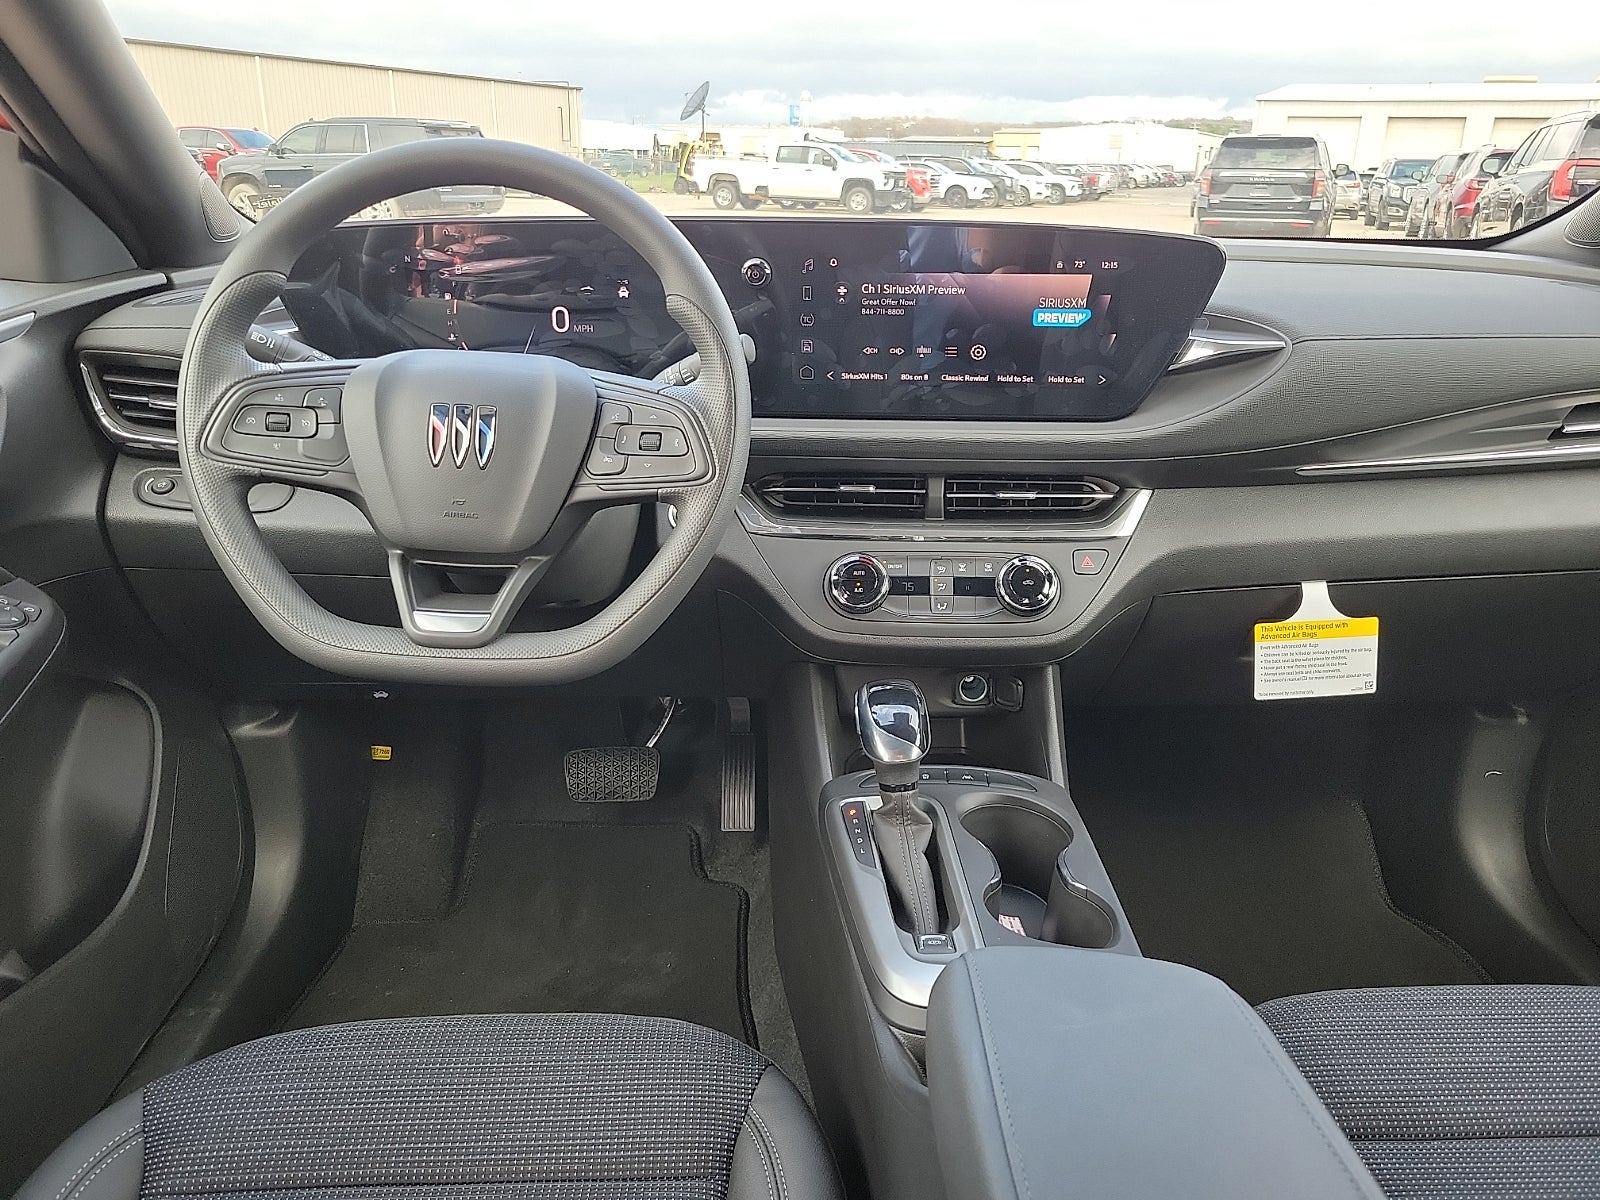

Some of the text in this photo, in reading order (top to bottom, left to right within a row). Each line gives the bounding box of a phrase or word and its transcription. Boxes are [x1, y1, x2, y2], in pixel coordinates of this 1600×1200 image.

[1101, 261, 1118, 269] 12:15
[861, 284, 875, 294] Ch
[883, 284, 926, 294] SiriusXM
[928, 284, 966, 294] Preview
[861, 298, 917, 306] Great Offer Now!
[1038, 298, 1087, 308] SIRIUSXM
[861, 308, 905, 316] 844-711-8800
[552, 306, 594, 333] 0 MPH
[1037, 312, 1087, 324] PREVIEW
[841, 372, 870, 380] SiriusXM
[941, 374, 989, 382] Classic Rewind
[1074, 376, 1085, 384] Set
[443, 511, 479, 520] AIRBAG
[902, 582, 915, 592] 75
[1275, 624, 1298, 632] Vehicle
[1305, 622, 1334, 632] Equipped
[1260, 632, 1290, 640] Advanced
[1302, 631, 1318, 639] Bags
